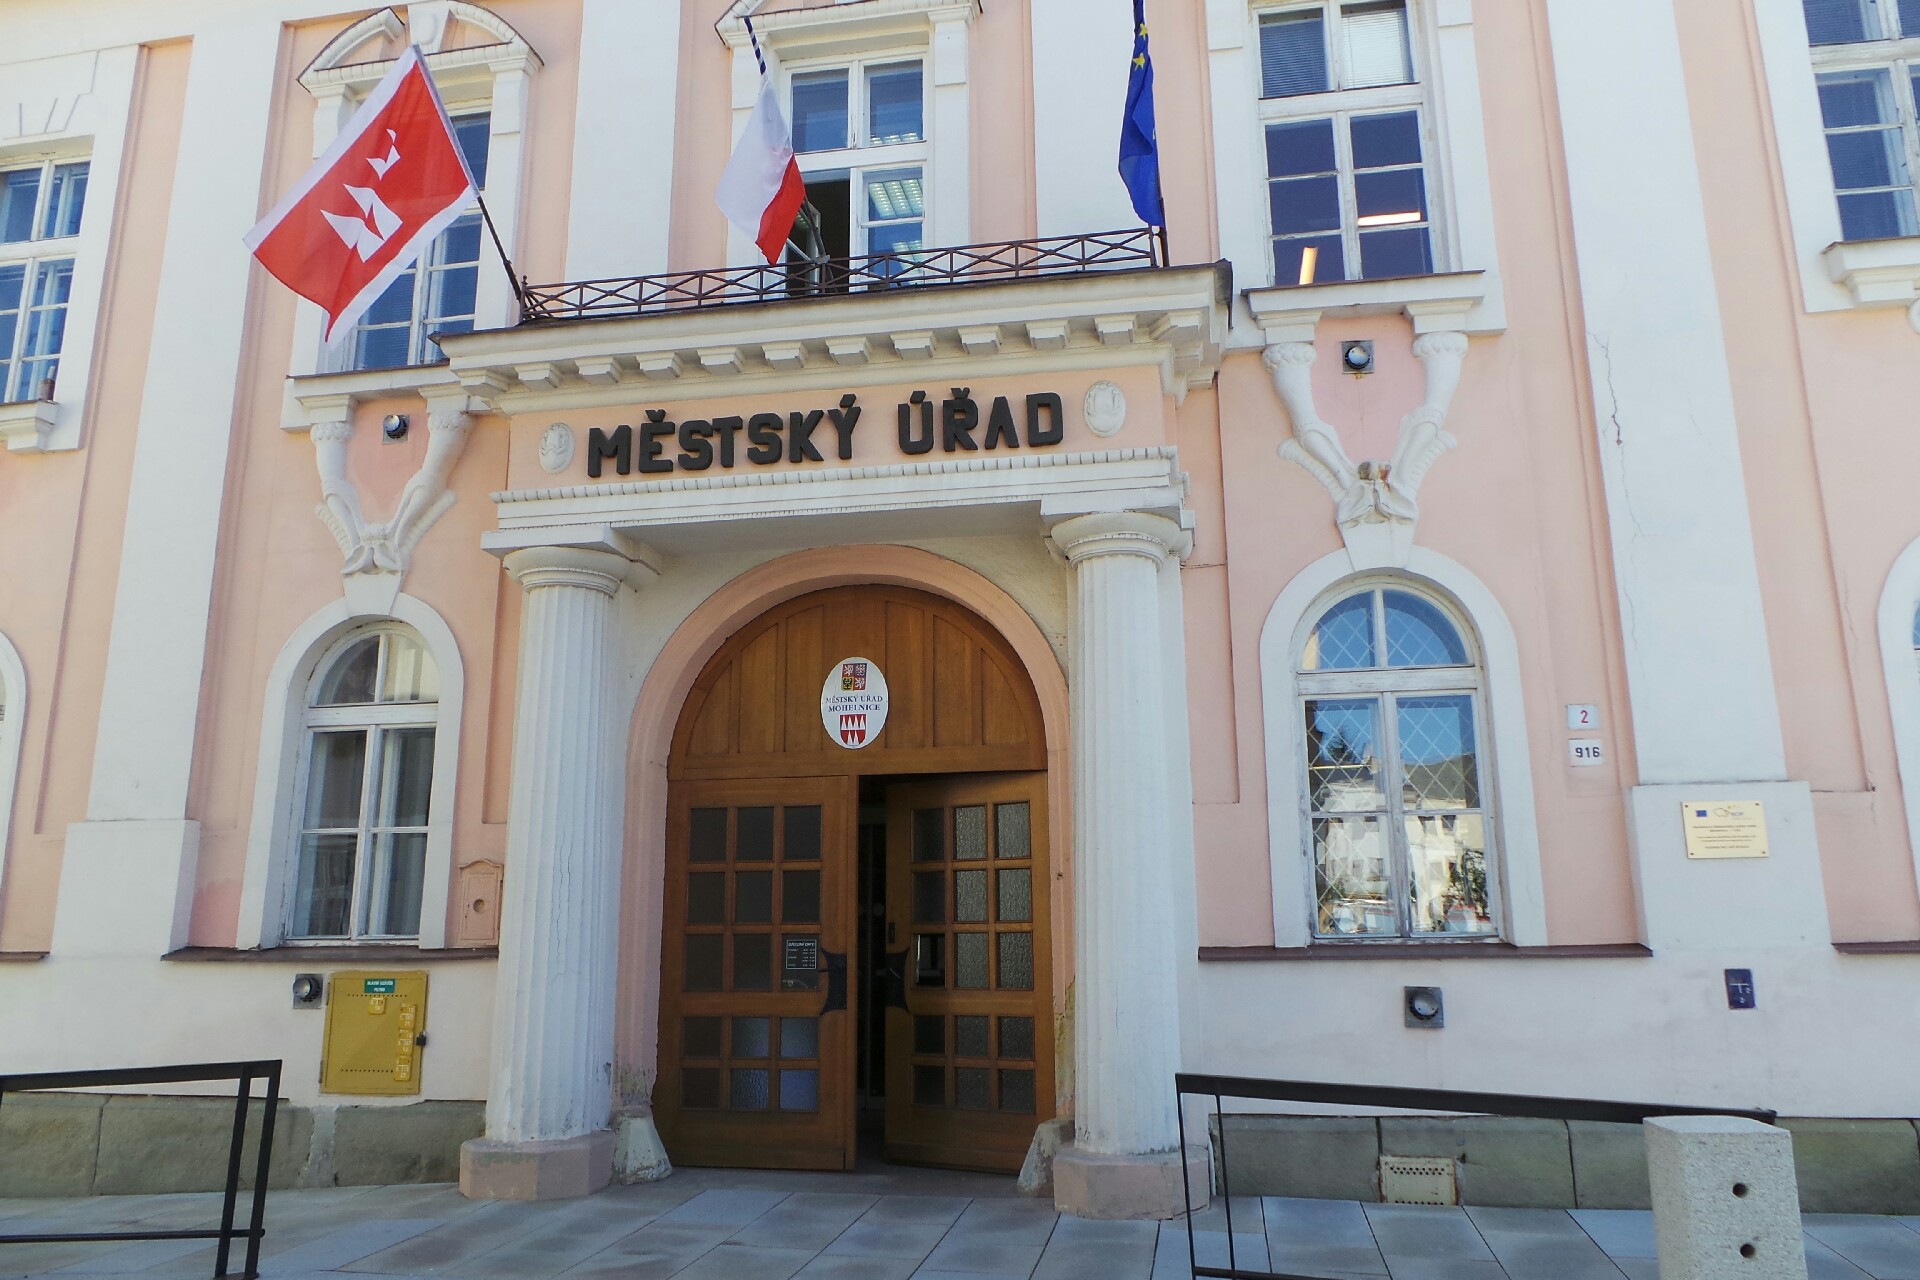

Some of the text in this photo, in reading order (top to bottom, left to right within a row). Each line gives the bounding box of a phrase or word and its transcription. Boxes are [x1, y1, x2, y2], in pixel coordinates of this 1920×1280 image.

[588, 387, 1064, 478] MĚSTSKÝ ÚŘAD
[826, 695, 858, 703] MĚSTSKÝ
[828, 704, 880, 712] MOHELNICE
[1580, 709, 1589, 724] 2
[1575, 746, 1600, 758] 916
